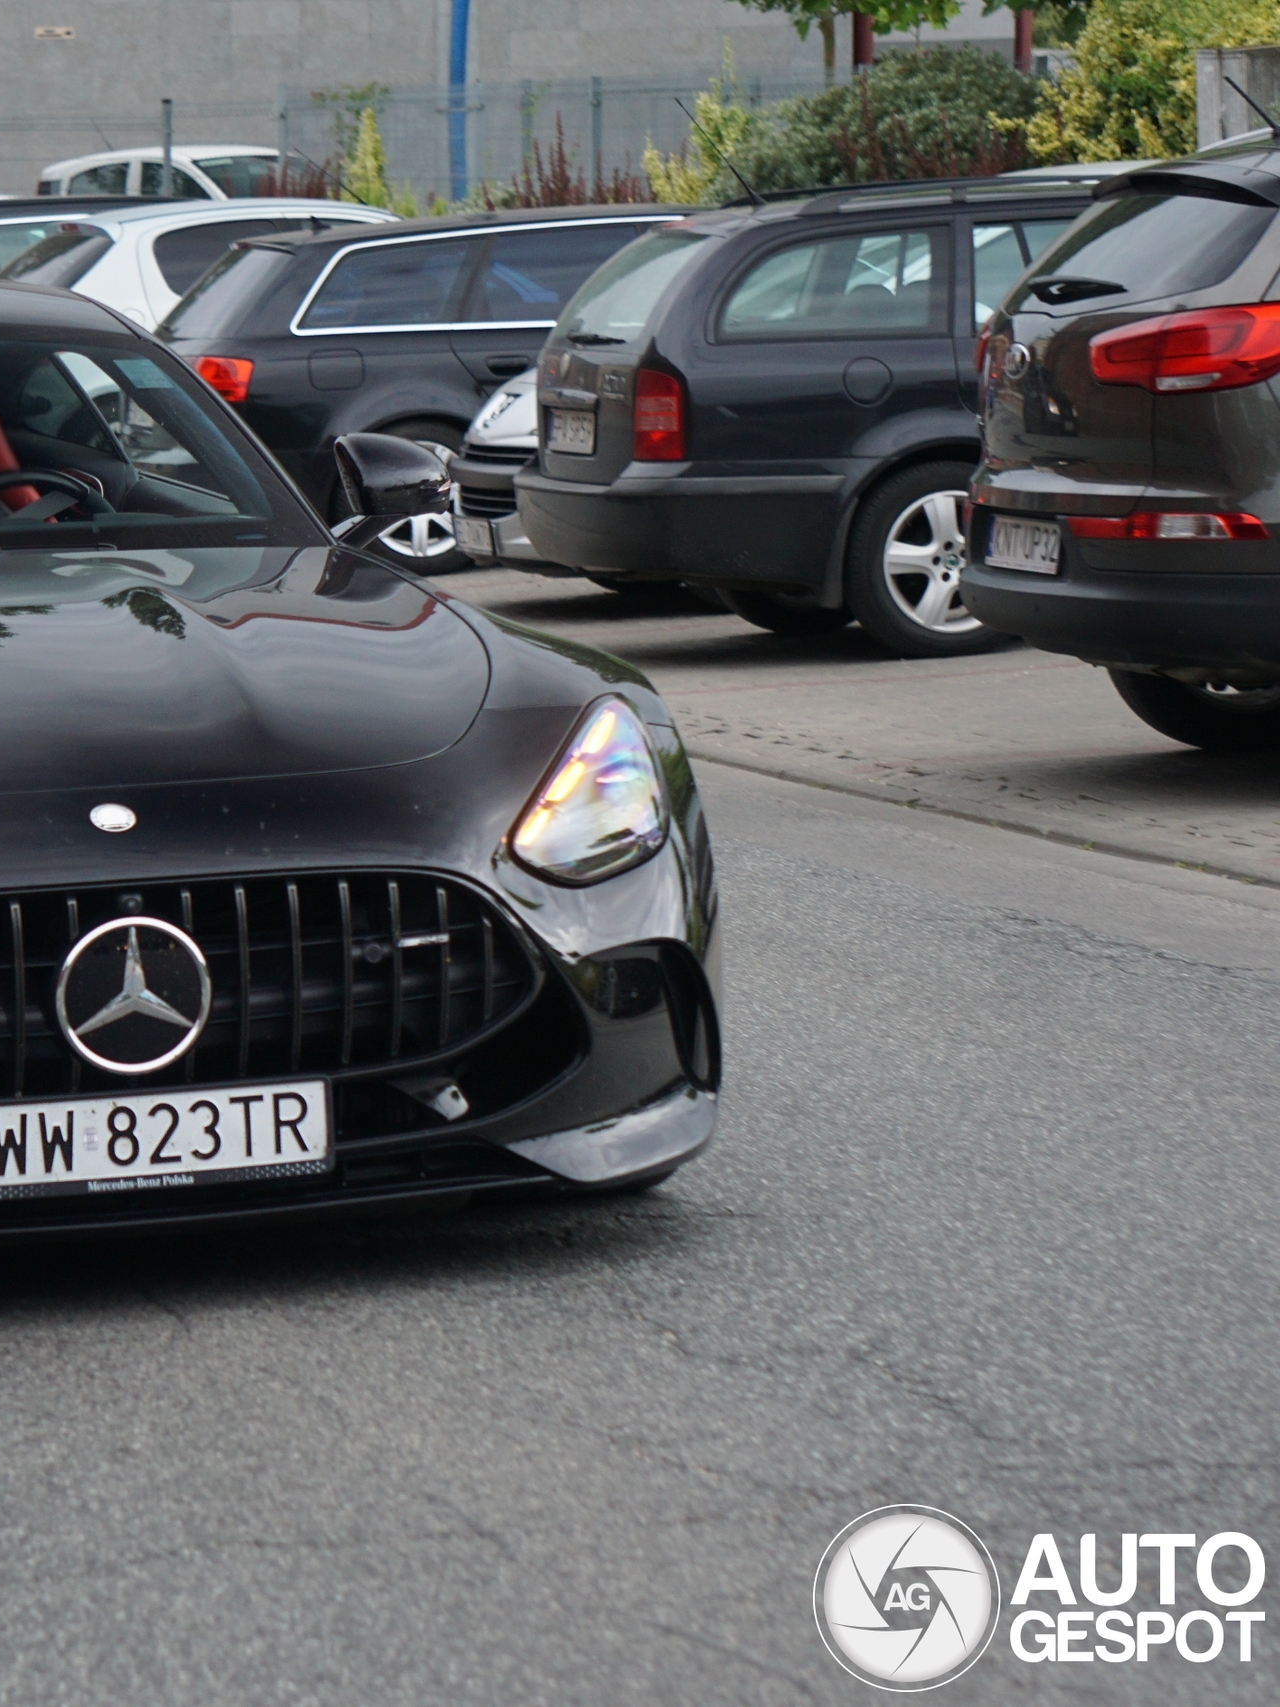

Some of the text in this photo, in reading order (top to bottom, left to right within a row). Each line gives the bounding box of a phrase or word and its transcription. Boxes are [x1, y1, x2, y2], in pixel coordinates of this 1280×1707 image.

[106, 1092, 310, 1167] 823TR
[87, 1174, 195, 1192] Mercedes-Benz Polska
